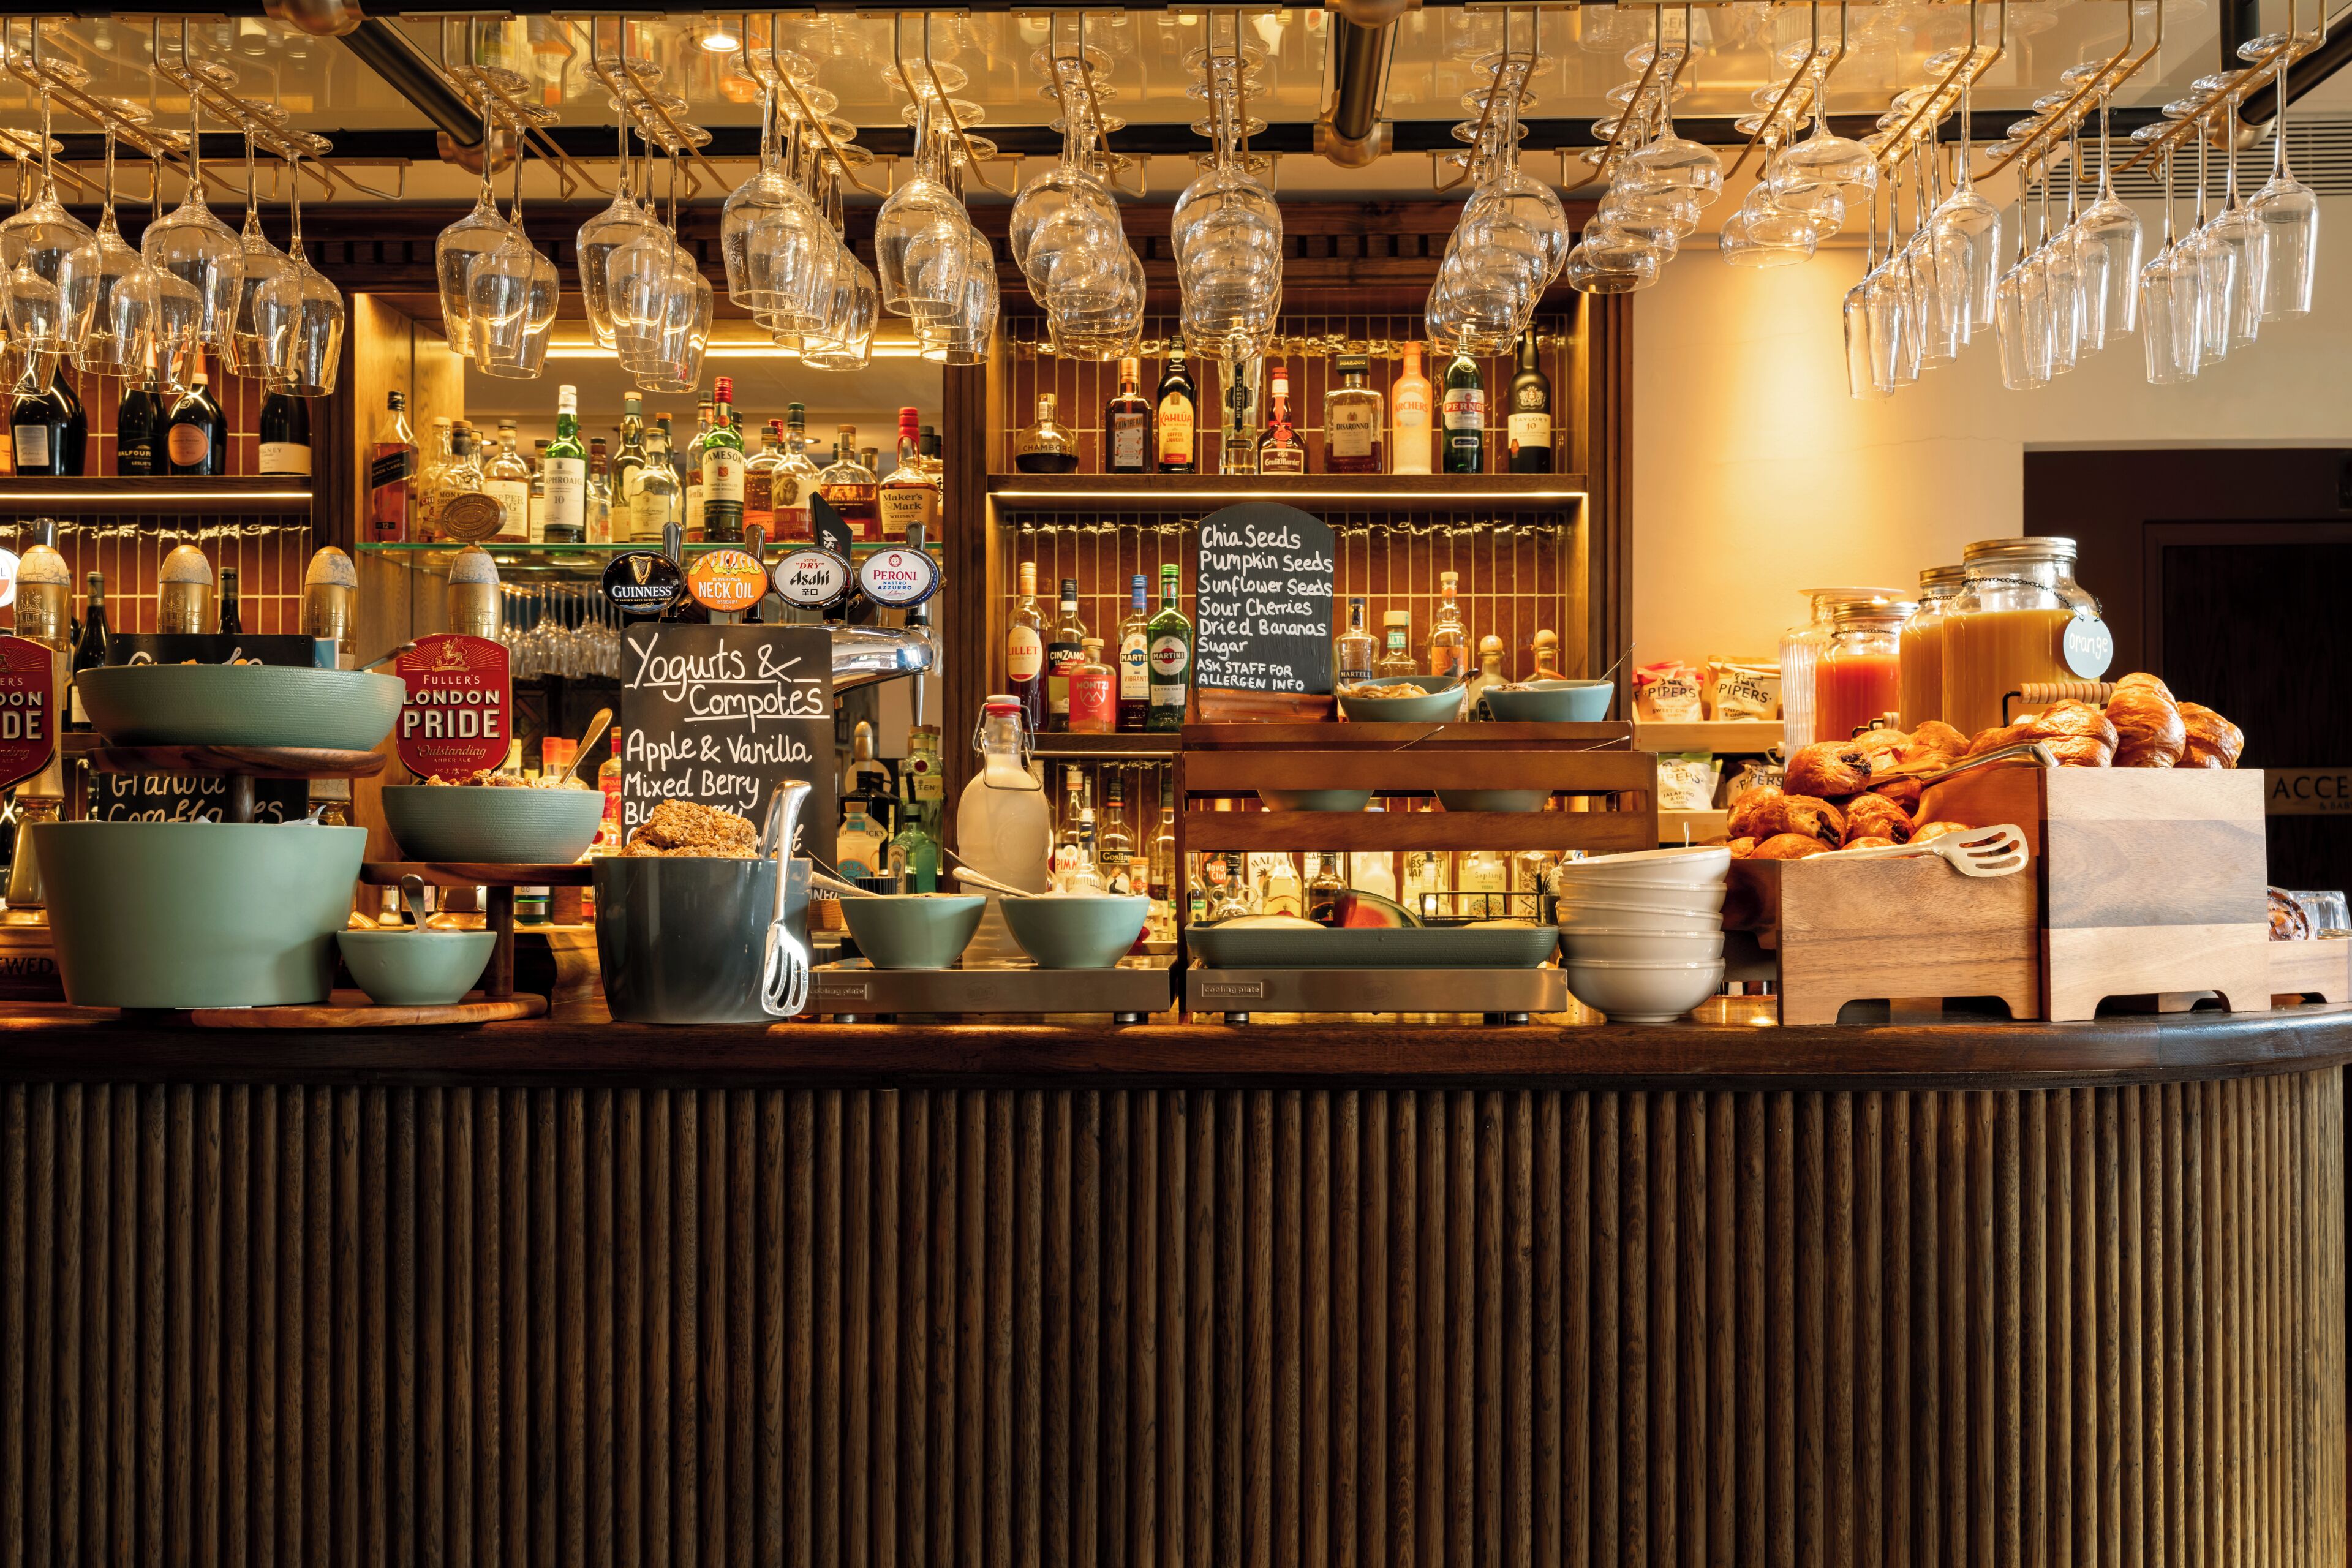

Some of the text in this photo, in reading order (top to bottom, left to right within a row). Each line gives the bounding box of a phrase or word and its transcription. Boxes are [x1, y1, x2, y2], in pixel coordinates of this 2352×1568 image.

[1396, 401, 1428, 413] ARCHERS
[1115, 417, 1142, 431] COINTREAU
[1160, 412, 1192, 427] KAHLÚA
[1336, 422, 1369, 431] DISARONNO
[1023, 443, 1072, 452] CHAMBORD
[704, 451, 742, 465] JAMESON
[546, 477, 582, 486] APHROAIG
[554, 496, 565, 504] 10
[883, 493, 922, 502] Maker's
[1201, 523, 1302, 549] Chia Seeds
[1200, 551, 1333, 576] Pumpkin Seeds
[790, 570, 829, 586] Asahi
[873, 570, 917, 581] PERONI
[612, 585, 672, 598] GUINNESS
[698, 582, 755, 598] NECK OIL
[1198, 573, 1333, 597] Sunflower Seeds
[1199, 597, 1313, 616] Sour Cherries
[1200, 618, 1327, 636] Dried Bananas
[1008, 646, 1039, 656] LILLET
[1197, 637, 1248, 661] Sugar
[2069, 633, 2108, 660] orange
[1050, 650, 1085, 661] CINZANO
[628, 633, 802, 703] Yogurts &
[1197, 658, 1293, 678] ASK STAFF FOR
[0, 676, 23, 687] ER'S
[423, 674, 480, 685] FULLER'S
[1076, 681, 1109, 690] MONTZI
[1198, 674, 1305, 692] ALLERGEN INFO
[404, 689, 500, 704] LONDON
[1648, 687, 1697, 698] PIPERS
[1719, 684, 1768, 704] PIPERS
[689, 682, 824, 733] Compotes
[404, 709, 500, 738] PRIDE
[417, 744, 486, 760] Outstanding
[626, 729, 812, 772] Apple & Vanilla
[624, 767, 760, 810] Mixed Berry
[2273, 775, 2349, 799] ACCE
[108, 799, 284, 824] Cornflaes
[1102, 853, 1133, 862] Gosling
[1207, 863, 1226, 872] Hava
[1475, 872, 1503, 881] Sapling
[0, 957, 54, 975] WED
[1238, 986, 1259, 994] plate
